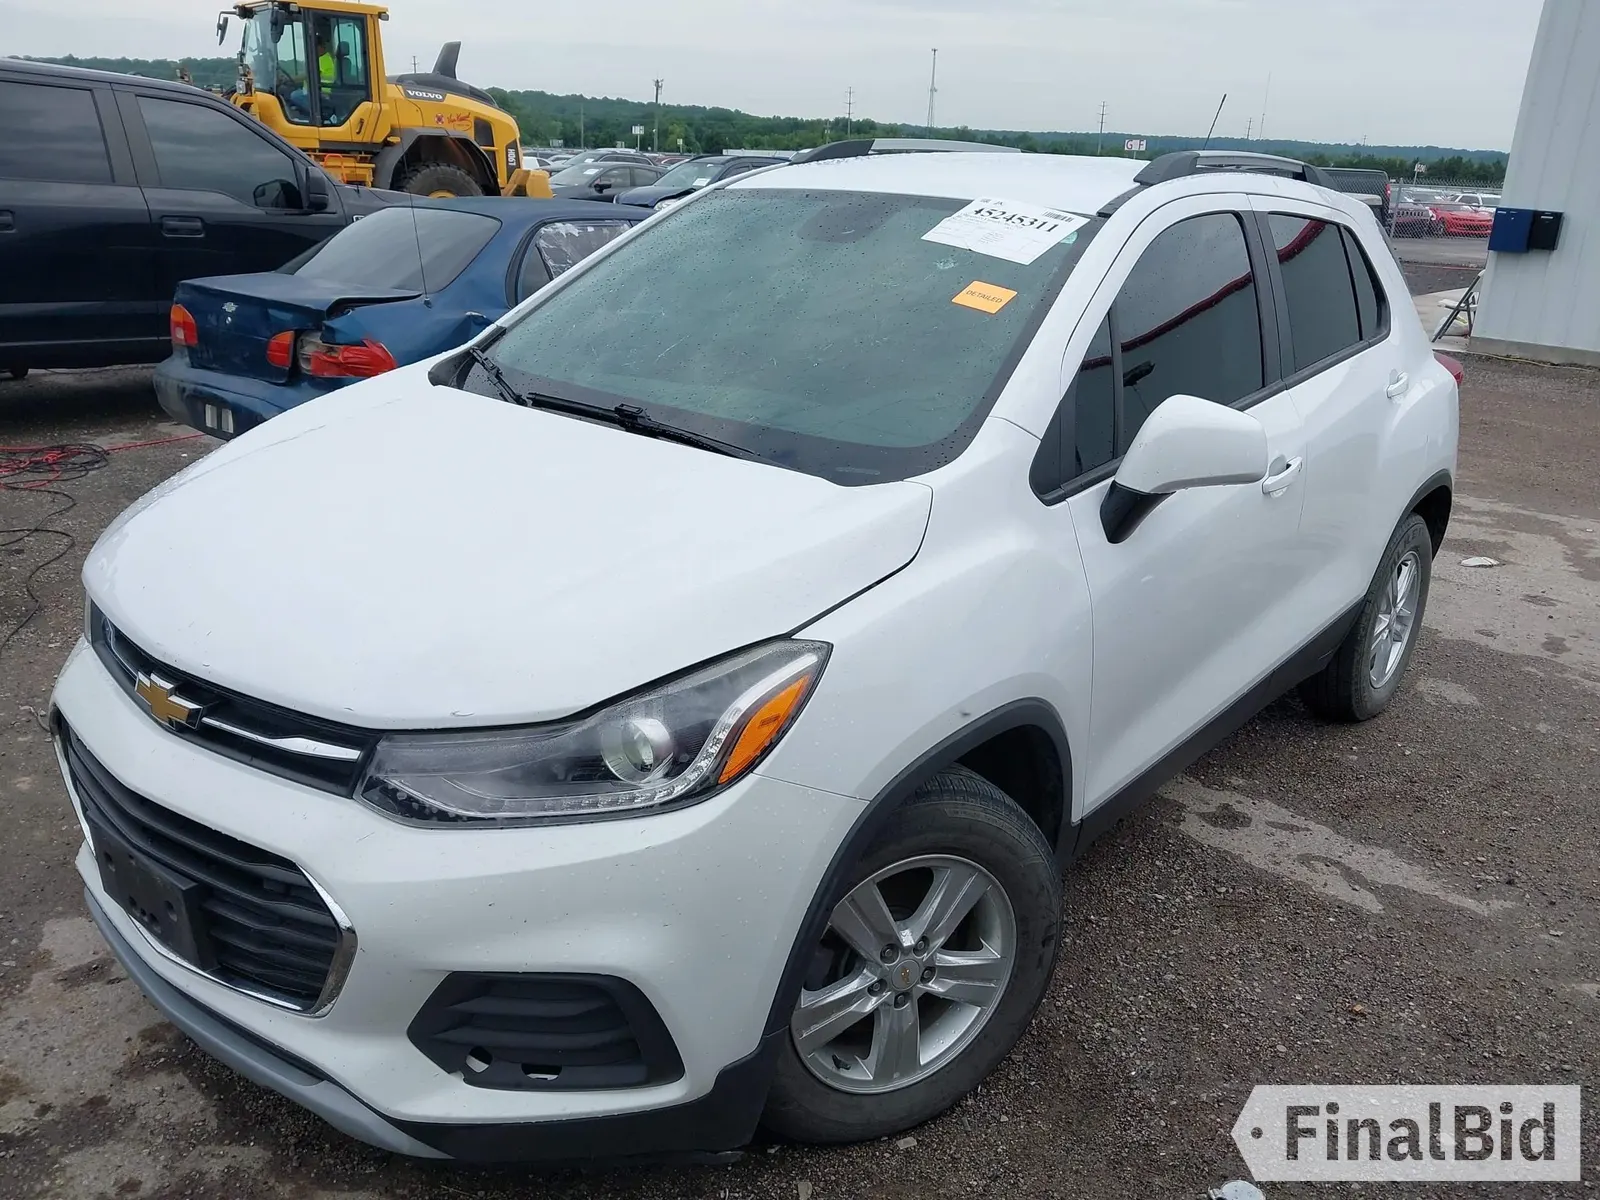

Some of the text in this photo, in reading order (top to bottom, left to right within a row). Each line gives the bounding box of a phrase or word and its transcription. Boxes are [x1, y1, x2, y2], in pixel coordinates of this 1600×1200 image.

[406, 89, 443, 99] VOLVO
[973, 206, 1059, 233] 45245311
[965, 289, 1003, 304] DETAILED
